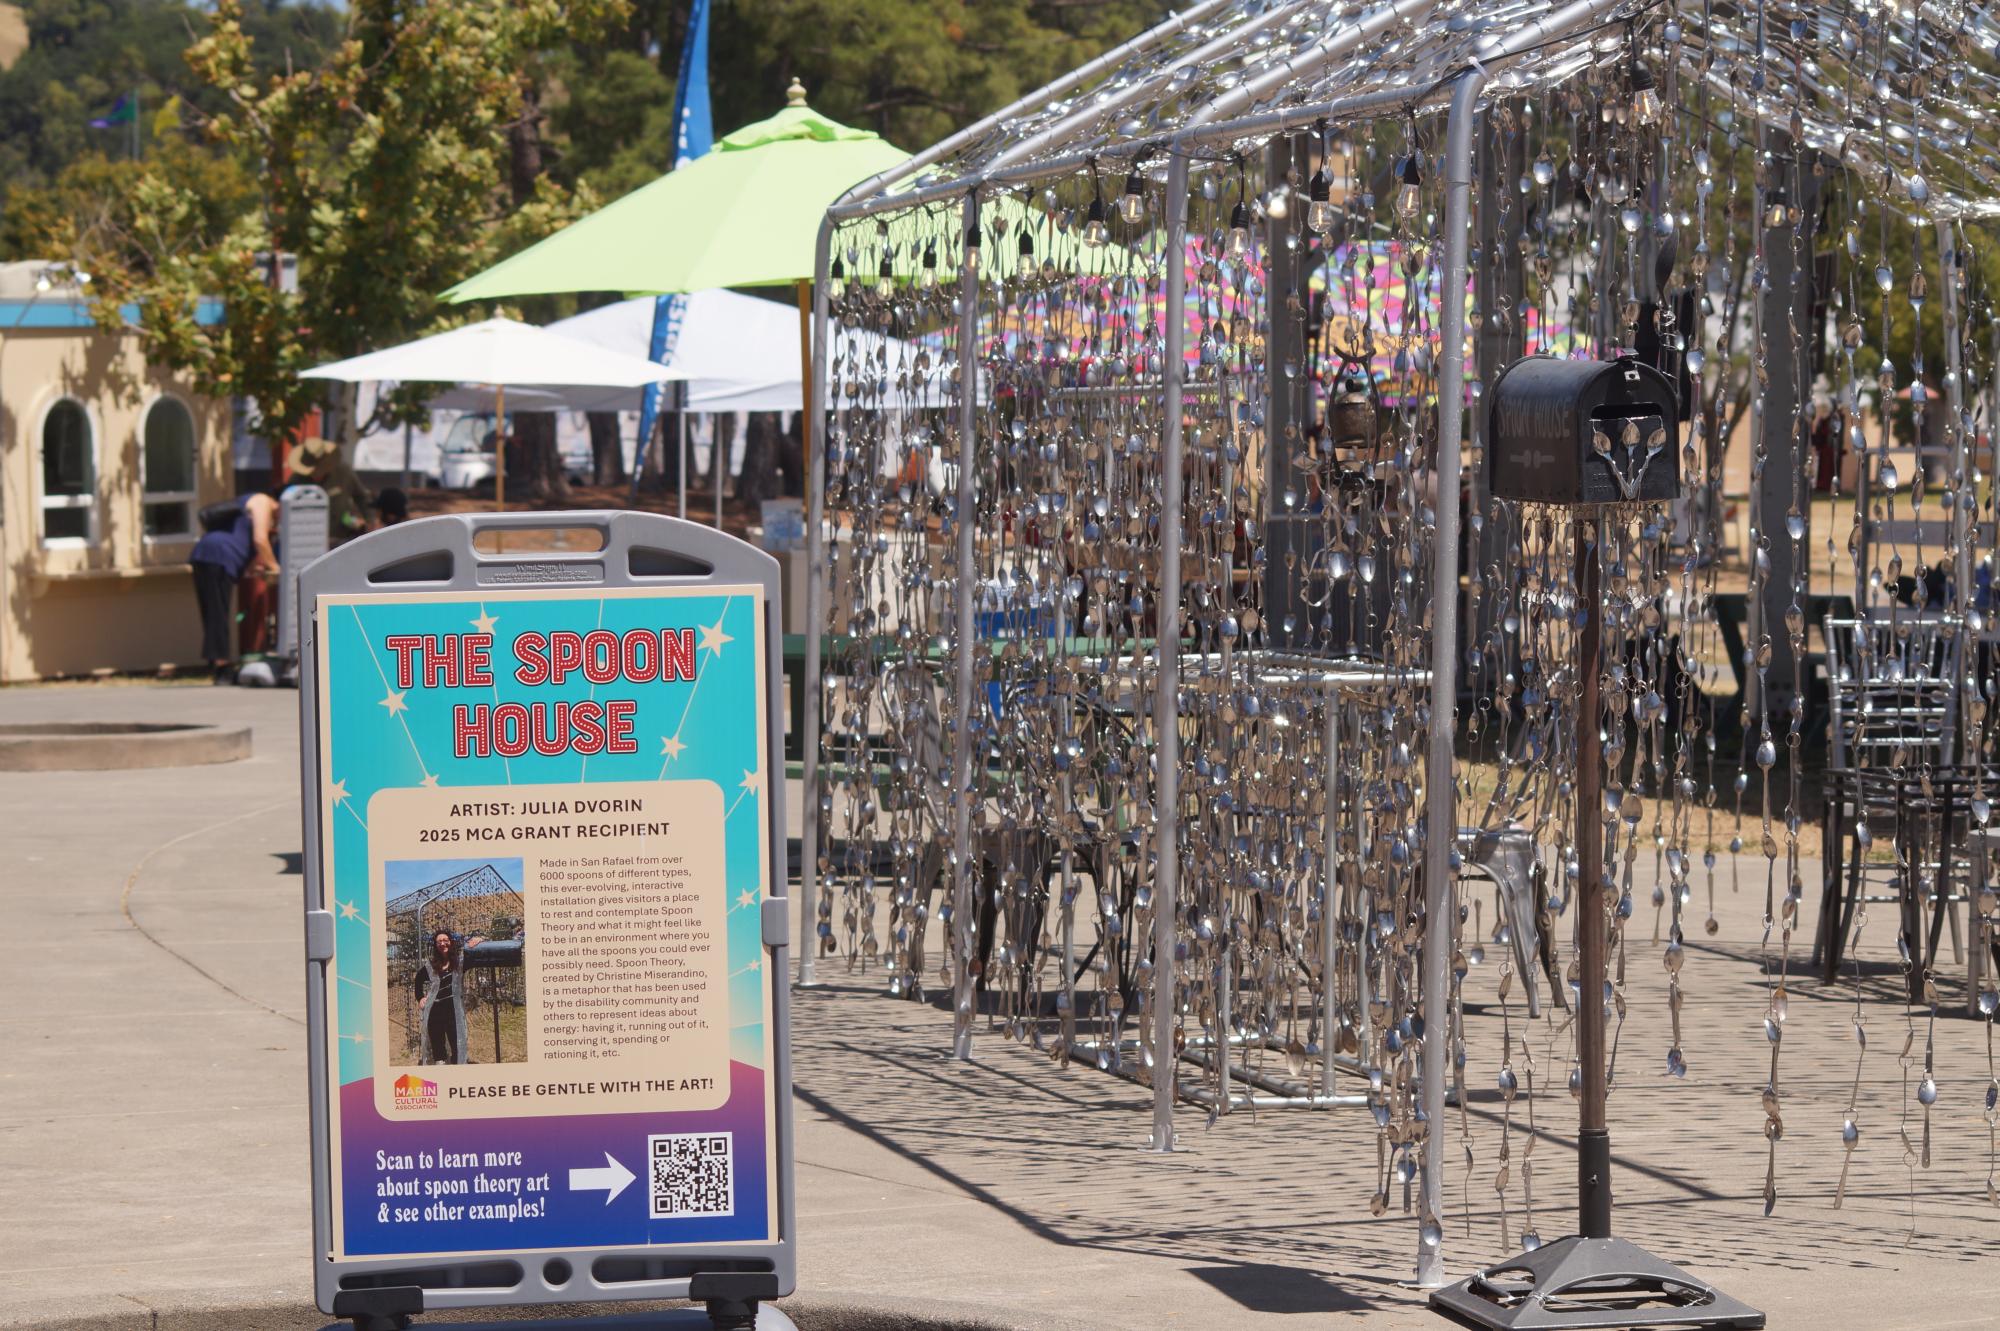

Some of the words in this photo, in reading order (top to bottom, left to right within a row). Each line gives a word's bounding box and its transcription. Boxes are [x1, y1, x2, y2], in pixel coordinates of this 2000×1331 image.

[386, 634, 494, 689] THE
[513, 628, 696, 686] SPOON
[454, 700, 637, 759] HOUSE
[449, 802, 514, 816] ARTIST:
[520, 801, 568, 815] JULIA
[574, 799, 641, 813] DVORIN
[419, 828, 460, 842] 2025
[466, 827, 505, 840] MCA
[511, 825, 571, 839] GRANT
[577, 822, 669, 837] RECIPIENT
[539, 858, 567, 867] Made
[581, 857, 599, 866] San
[602, 856, 634, 865] Rafael
[636, 855, 659, 864] from
[539, 871, 564, 880] 6000
[566, 871, 603, 881] spoons
[605, 869, 615, 878] of
[617, 868, 659, 878] different
[661, 869, 691, 878] types,
[540, 884, 558, 893] this
[560, 882, 629, 892] ever-evolving,
[632, 880, 683, 890] interactive
[540, 896, 595, 906] installation
[598, 895, 623, 906] gives
[625, 894, 661, 903] visitors
[672, 892, 699, 903] place
[553, 910, 572, 918] rest
[574, 908, 593, 918] and
[595, 907, 658, 917] contemplate
[661, 906, 692, 916] Spoon
[541, 922, 574, 932] Theory
[577, 921, 595, 930] and
[597, 920, 622, 929] what
[633, 919, 661, 930] might
[664, 918, 682, 927] feel
[684, 918, 701, 926] like
[553, 935, 566, 944] be
[594, 933, 657, 943] environment
[659, 931, 689, 940] where
[691, 932, 709, 941] you
[541, 948, 565, 956] have
[567, 947, 579, 956] all
[582, 947, 598, 955] the
[600, 947, 637, 956] spoons
[639, 946, 656, 956] you
[659, 943, 687, 953] could
[542, 960, 583, 972] possibly
[585, 959, 613, 968] need.
[615, 958, 647, 968] Spoon
[651, 957, 685, 967] Theory,
[542, 972, 580, 982] created
[582, 972, 594, 983] by
[596, 971, 641, 981] Christine
[644, 969, 707, 979] Miserandino,
[561, 985, 610, 995] metaphor
[612, 984, 632, 993] that
[634, 983, 652, 992] has
[655, 982, 679, 991] been
[682, 981, 706, 990] used
[542, 999, 554, 1010] by
[556, 999, 572, 1007] the
[575, 997, 620, 1007] disability
[622, 996, 678, 1006] community
[680, 994, 699, 1003] and
[543, 1012, 574, 1020] others
[589, 1010, 637, 1020] represent
[639, 1008, 666, 1017] ideas
[668, 1007, 697, 1016] about
[543, 1025, 579, 1035] energy:
[582, 1023, 614, 1033] having
[616, 1022, 626, 1032] it,
[628, 1022, 666, 1031] running
[668, 1020, 684, 1029] out
[687, 1019, 697, 1028] of
[699, 1019, 708, 1028] it,
[543, 1036, 598, 1046] conserving
[600, 1036, 609, 1045] it,
[612, 1034, 658, 1045] spending
[544, 1049, 588, 1060] rationing
[589, 1050, 599, 1058] it,
[601, 1049, 620, 1057] etc.
[396, 1086, 436, 1097] MARIN
[448, 1085, 506, 1098] PLEASE
[511, 1084, 530, 1096] BE
[535, 1082, 595, 1095] GENTLE
[599, 1080, 640, 1093] WITH
[645, 1079, 674, 1091] THE
[679, 1078, 712, 1090] ART!
[376, 1149, 413, 1170] Scan
[418, 1151, 433, 1169] to
[438, 1148, 478, 1168] learn
[484, 1151, 521, 1166] more
[376, 1176, 420, 1196] about
[424, 1179, 468, 1198] spoon
[473, 1172, 521, 1196] theory
[526, 1172, 549, 1191] art
[377, 1202, 389, 1223] &
[394, 1207, 418, 1222] see
[424, 1200, 464, 1221] other
[469, 1196, 544, 1222] examples!
